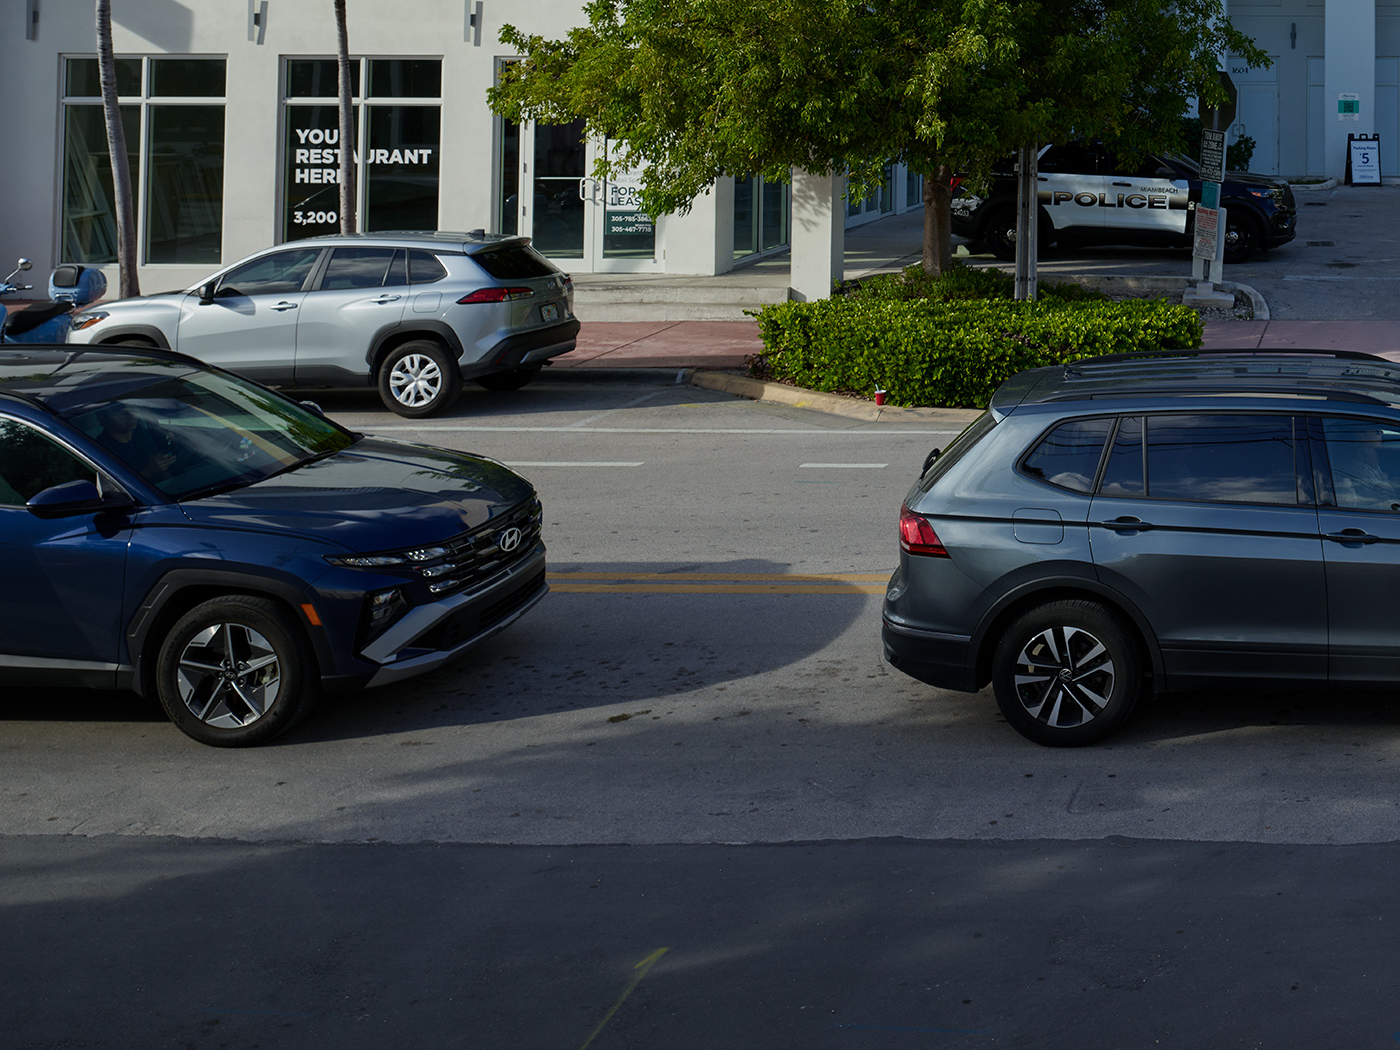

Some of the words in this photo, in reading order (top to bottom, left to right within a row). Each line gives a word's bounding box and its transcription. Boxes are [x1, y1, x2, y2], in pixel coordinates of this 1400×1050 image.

[296, 129, 339, 145] YOU
[611, 197, 645, 206] LEAS
[1053, 191, 1167, 209] POLICE
[293, 211, 338, 226] 3,200
